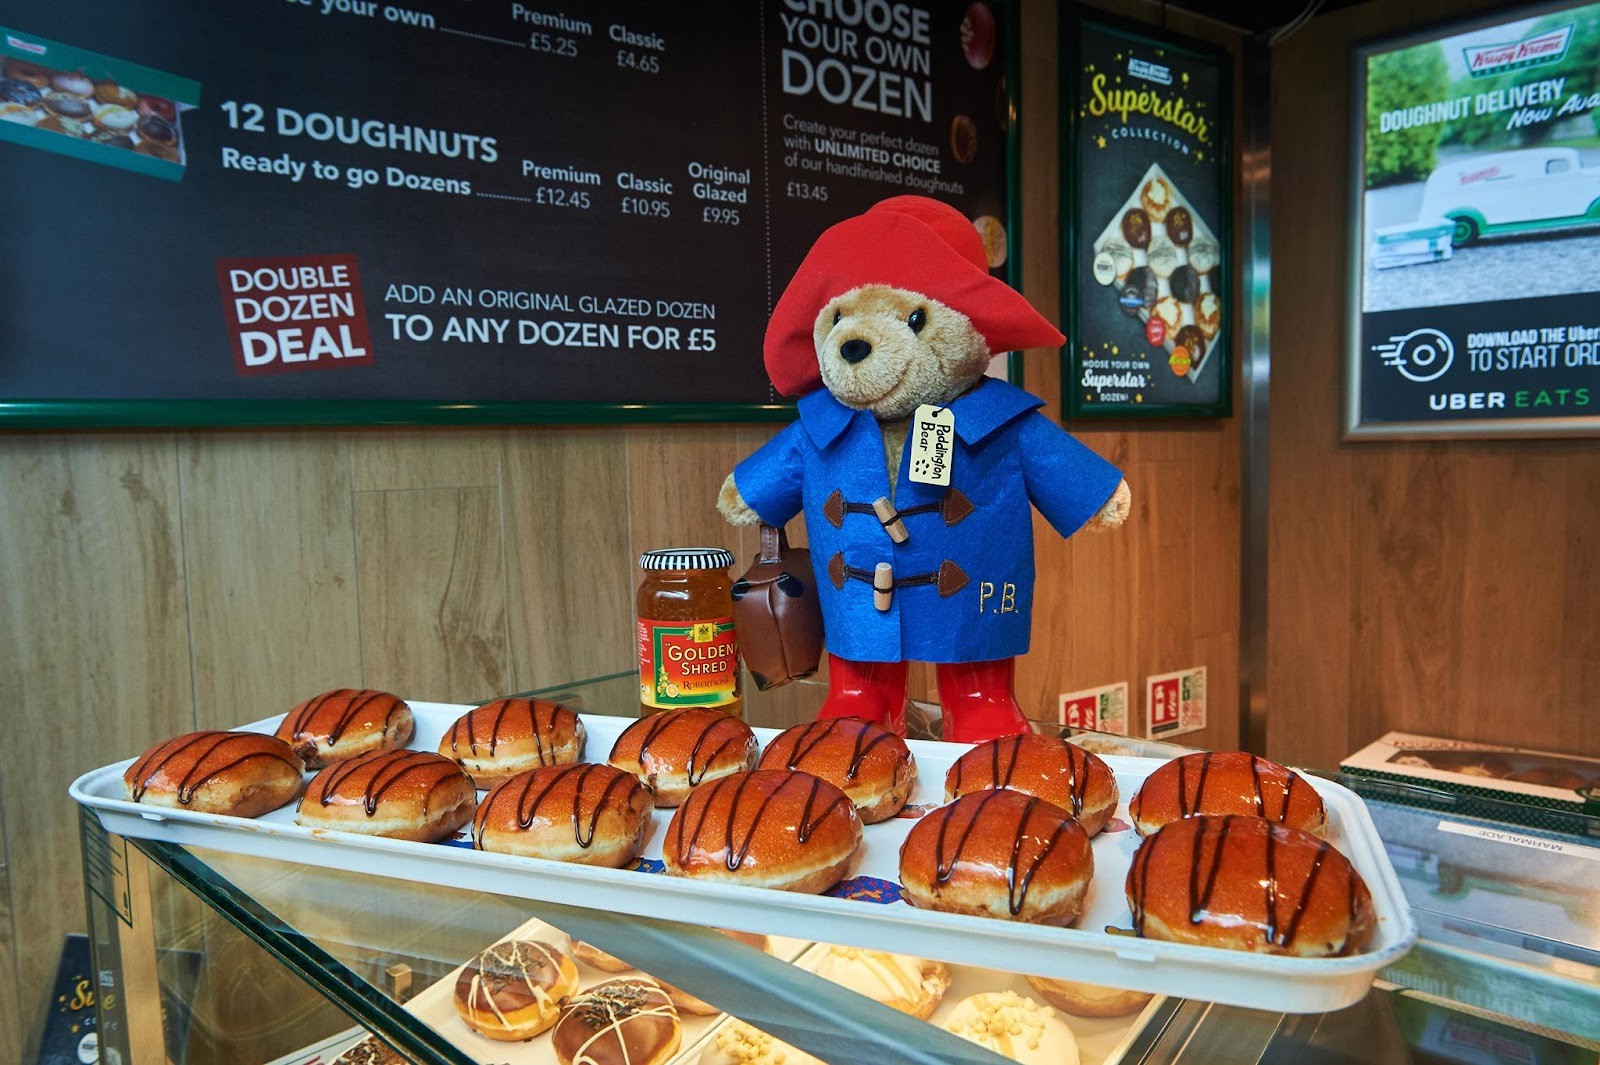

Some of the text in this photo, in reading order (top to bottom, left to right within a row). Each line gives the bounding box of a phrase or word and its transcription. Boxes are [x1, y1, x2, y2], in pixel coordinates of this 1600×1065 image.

[320, 0, 436, 29] your own
[512, 3, 592, 35] Premium
[530, 32, 578, 57] £5.25
[609, 24, 665, 51] Classic
[780, 12, 931, 76] YOUR OWN
[616, 50, 660, 74] £4.65
[782, 48, 932, 123] DOZEN
[1089, 73, 1208, 143] Superstar
[1380, 77, 1566, 133] DOUGHNUT DELIVERY
[1506, 107, 1553, 131] Now
[220, 100, 499, 163] 12 DOUGHNUTS
[783, 113, 939, 157] Create your perfect dozen
[1111, 126, 1189, 156] COLLECTION
[783, 134, 941, 174] with UNLIMITED CHOICE
[221, 146, 472, 196] Ready to go Dozens
[521, 159, 601, 186] Premium
[616, 172, 674, 195] Classic
[687, 161, 751, 185] Original
[784, 152, 964, 195] of our handfinished doughnuts
[536, 186, 591, 209] £12.45
[692, 182, 748, 205] Glazed
[787, 181, 828, 202] £13.45
[621, 196, 671, 219] £10.95
[702, 206, 741, 226] £9.95
[229, 265, 351, 293] DOUBLE
[235, 292, 356, 324] DOZEN
[384, 283, 716, 321] ADD AN ORIGINAL GLAZED DOZEN
[240, 324, 367, 367] DEAL
[384, 312, 717, 352] TO ANY DOZEN FOR £5
[1467, 329, 1538, 349] DOWNLOAD
[1540, 327, 1567, 343] THE
[1468, 349, 1492, 372] TO
[1496, 344, 1560, 371] START
[1081, 368, 1147, 394] Superstar
[1429, 388, 1590, 411] UBER EATS
[919, 421, 936, 452] Bear
[931, 424, 951, 479] Paddington
[980, 581, 1018, 614] P.B.
[1479, 830, 1563, 851] MARMALADE
